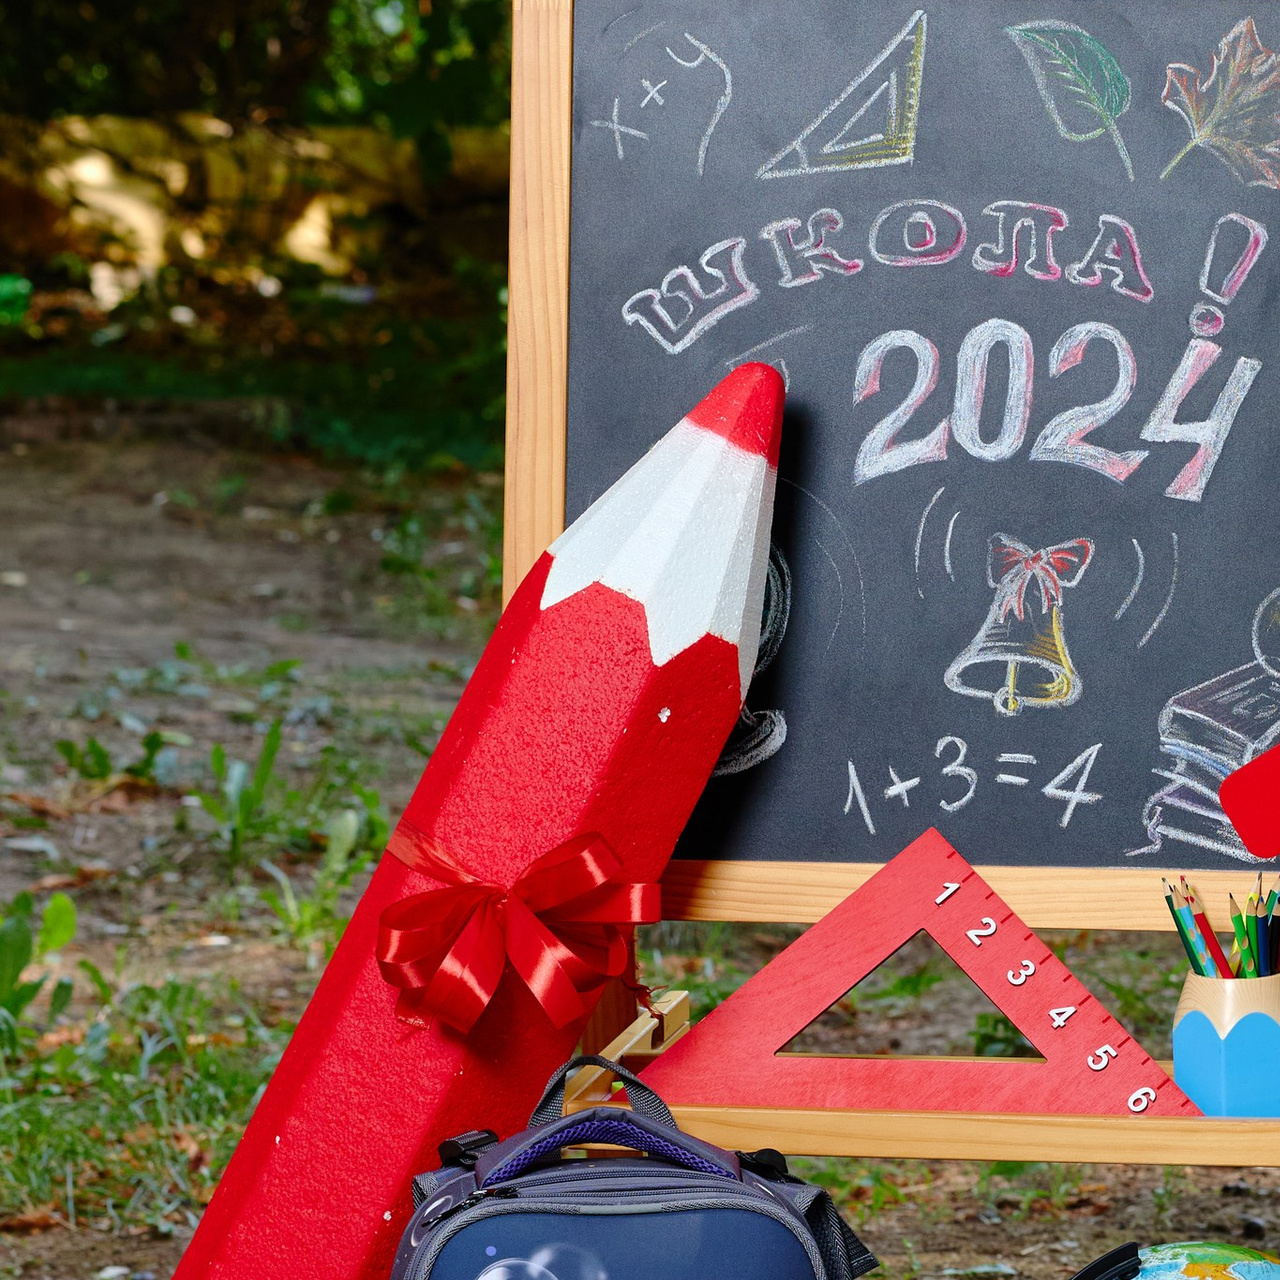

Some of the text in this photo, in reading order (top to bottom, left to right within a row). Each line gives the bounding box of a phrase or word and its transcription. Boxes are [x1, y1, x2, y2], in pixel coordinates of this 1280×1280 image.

[851, 317, 1264, 504] 2024
[934, 881, 1157, 1112] 1 2 3 4 5 6
